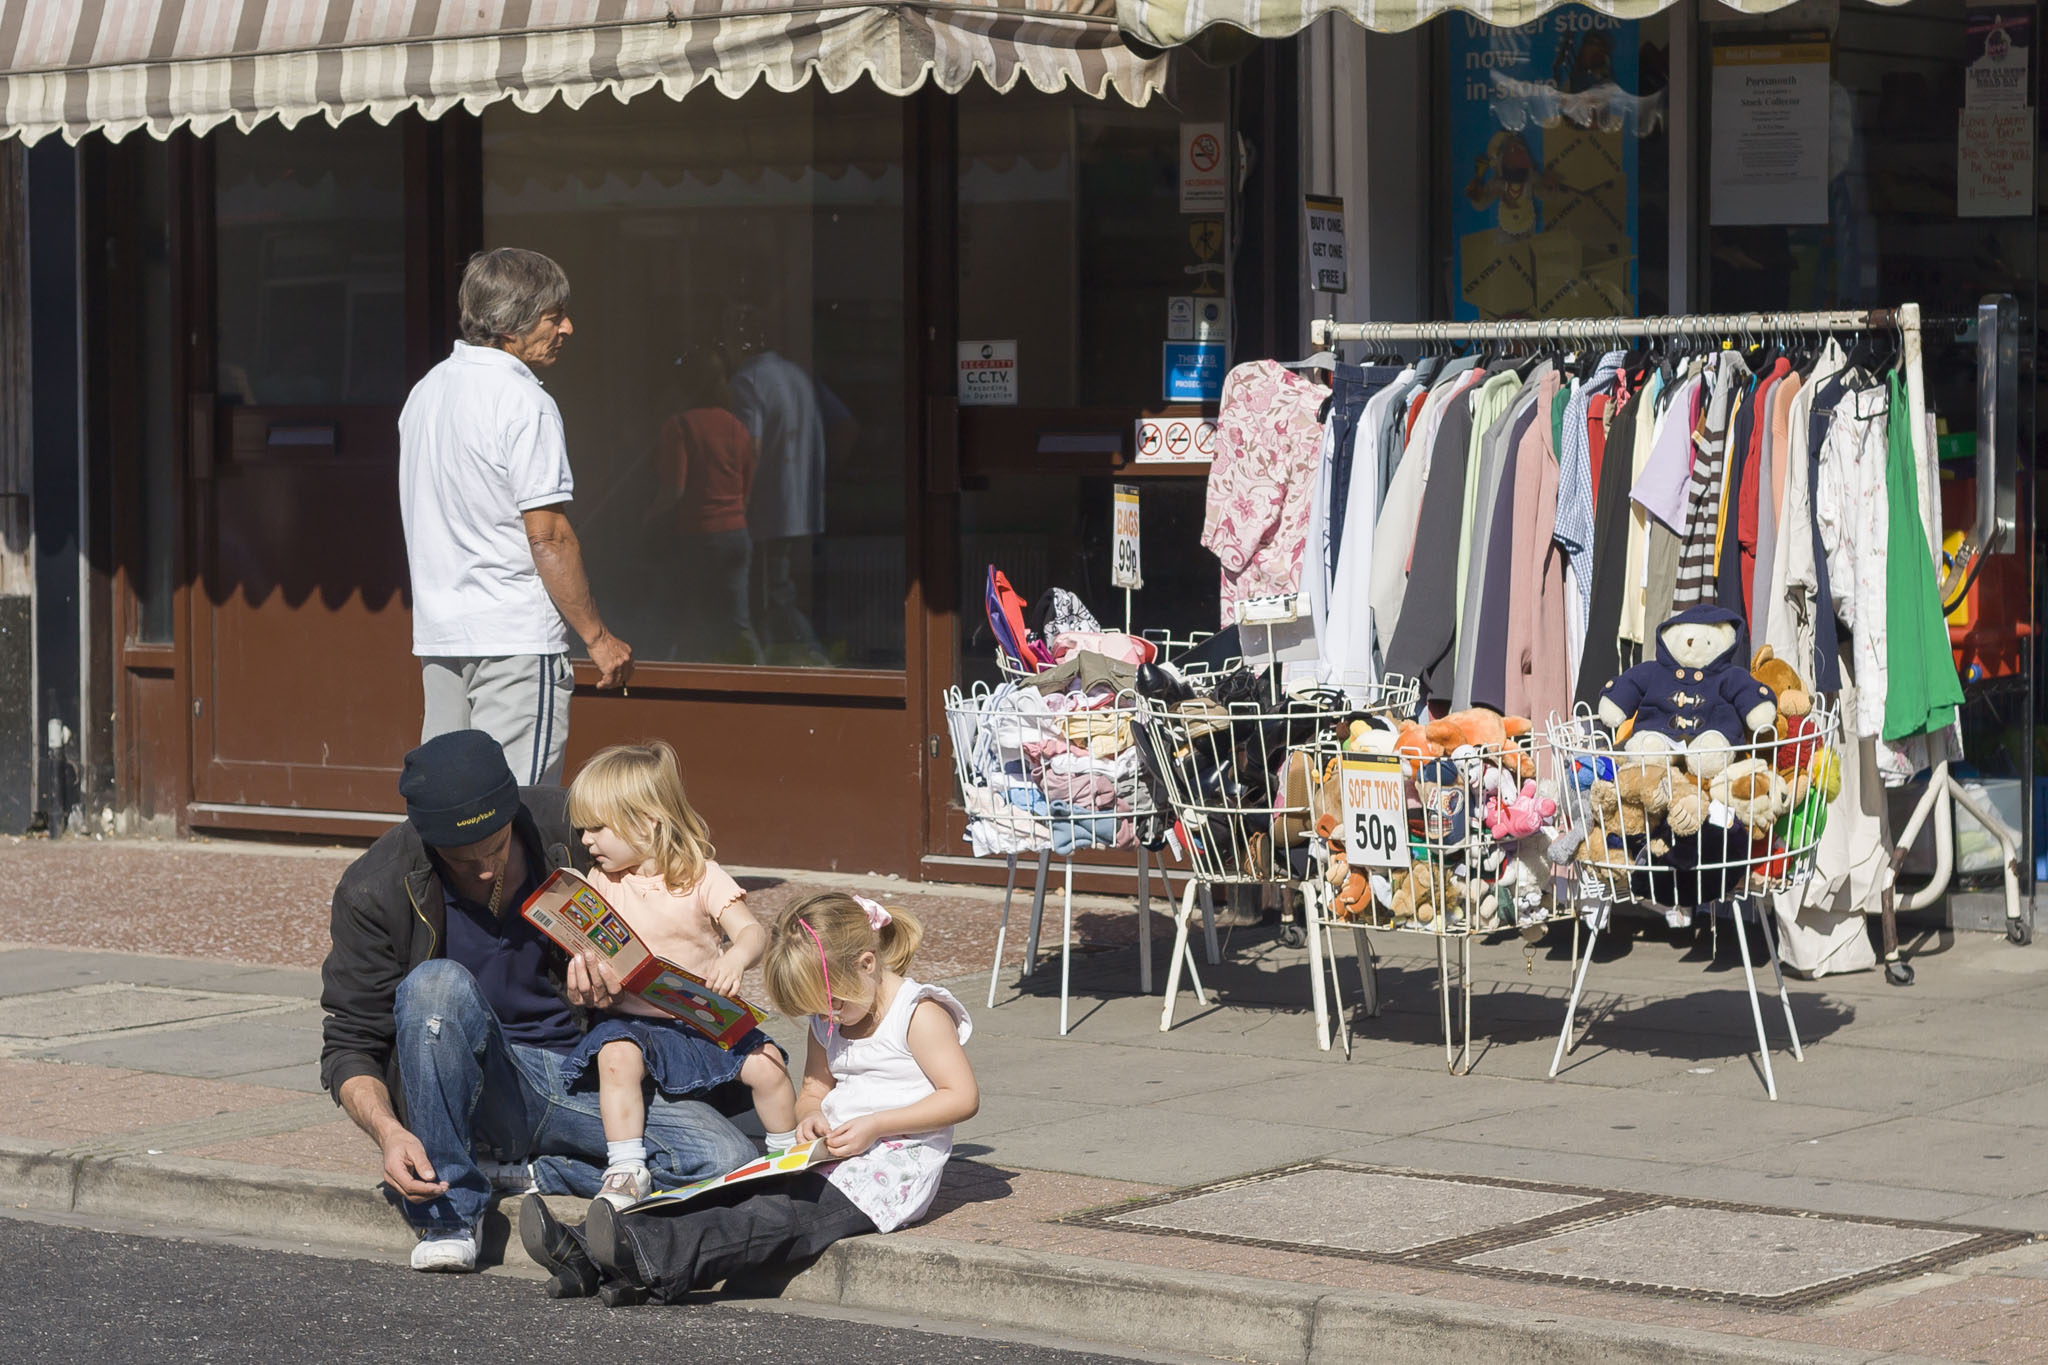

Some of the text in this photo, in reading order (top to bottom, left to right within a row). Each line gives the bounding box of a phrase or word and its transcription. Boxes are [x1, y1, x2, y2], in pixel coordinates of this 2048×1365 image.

[1465, 49, 1519, 70] now
[1465, 77, 1557, 101] in-store
[1745, 75, 1797, 87] Portsmouth
[1310, 216, 1325, 231] BUY
[1312, 242, 1343, 259] GET ONE
[1320, 269, 1339, 285] FREE
[961, 360, 1014, 369] SECURITY
[1178, 353, 1216, 364] THIEVES
[966, 371, 1009, 384] C.C.T.V.
[968, 384, 1008, 393] Recording
[974, 391, 1013, 401] Operation
[1117, 508, 1138, 537] BAGS
[1118, 539, 1137, 580] 99p
[1348, 777, 1371, 809] SOFT
[1374, 780, 1400, 812] TOYS
[1355, 813, 1397, 861] 50p
